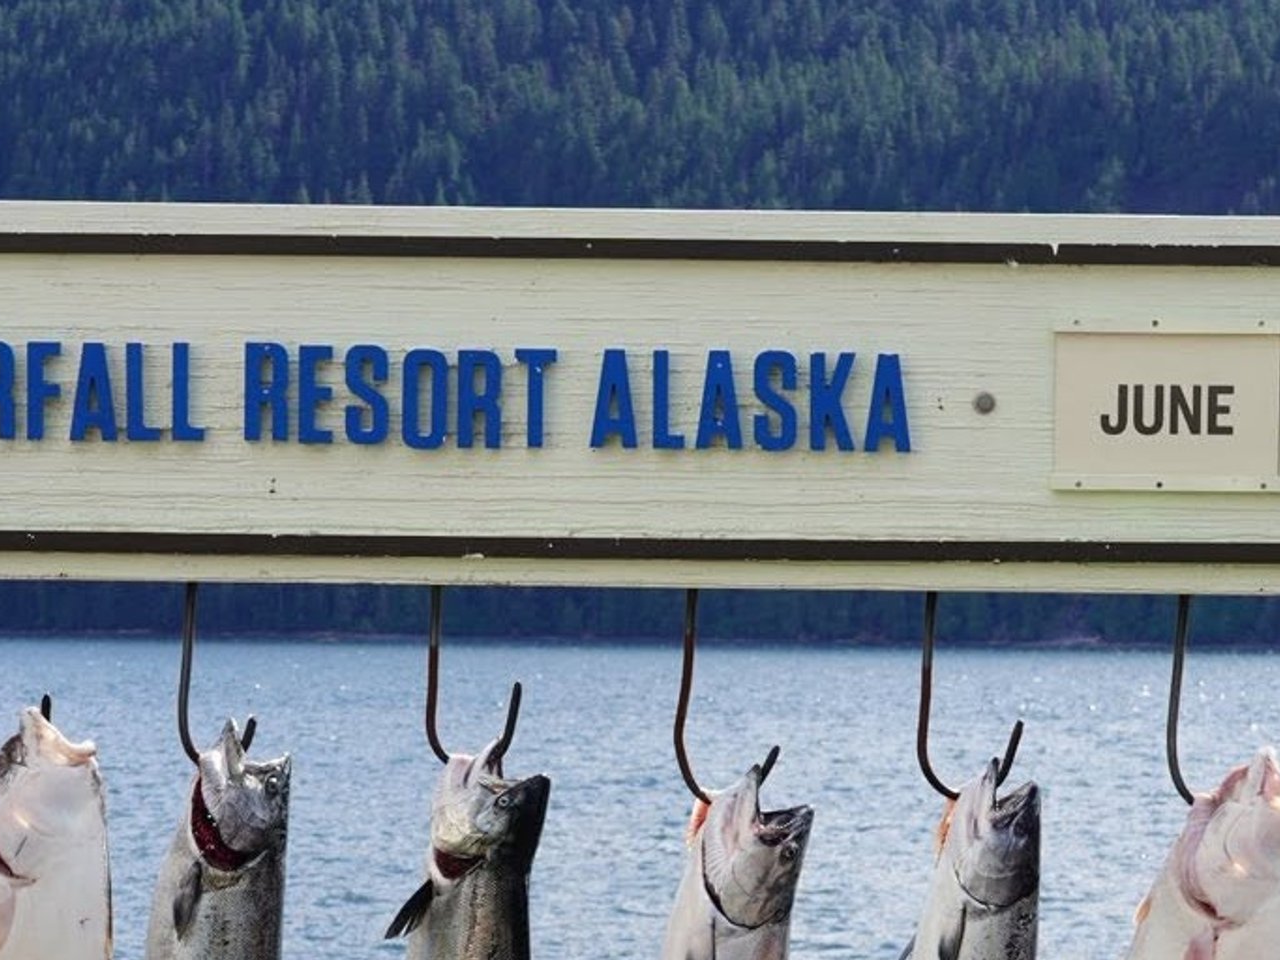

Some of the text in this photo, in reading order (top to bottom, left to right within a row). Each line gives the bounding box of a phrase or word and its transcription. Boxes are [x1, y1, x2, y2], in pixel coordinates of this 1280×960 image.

[244, 341, 559, 449] RESORT
[590, 348, 911, 452] ALASKA
[1101, 384, 1234, 435] JUNE
